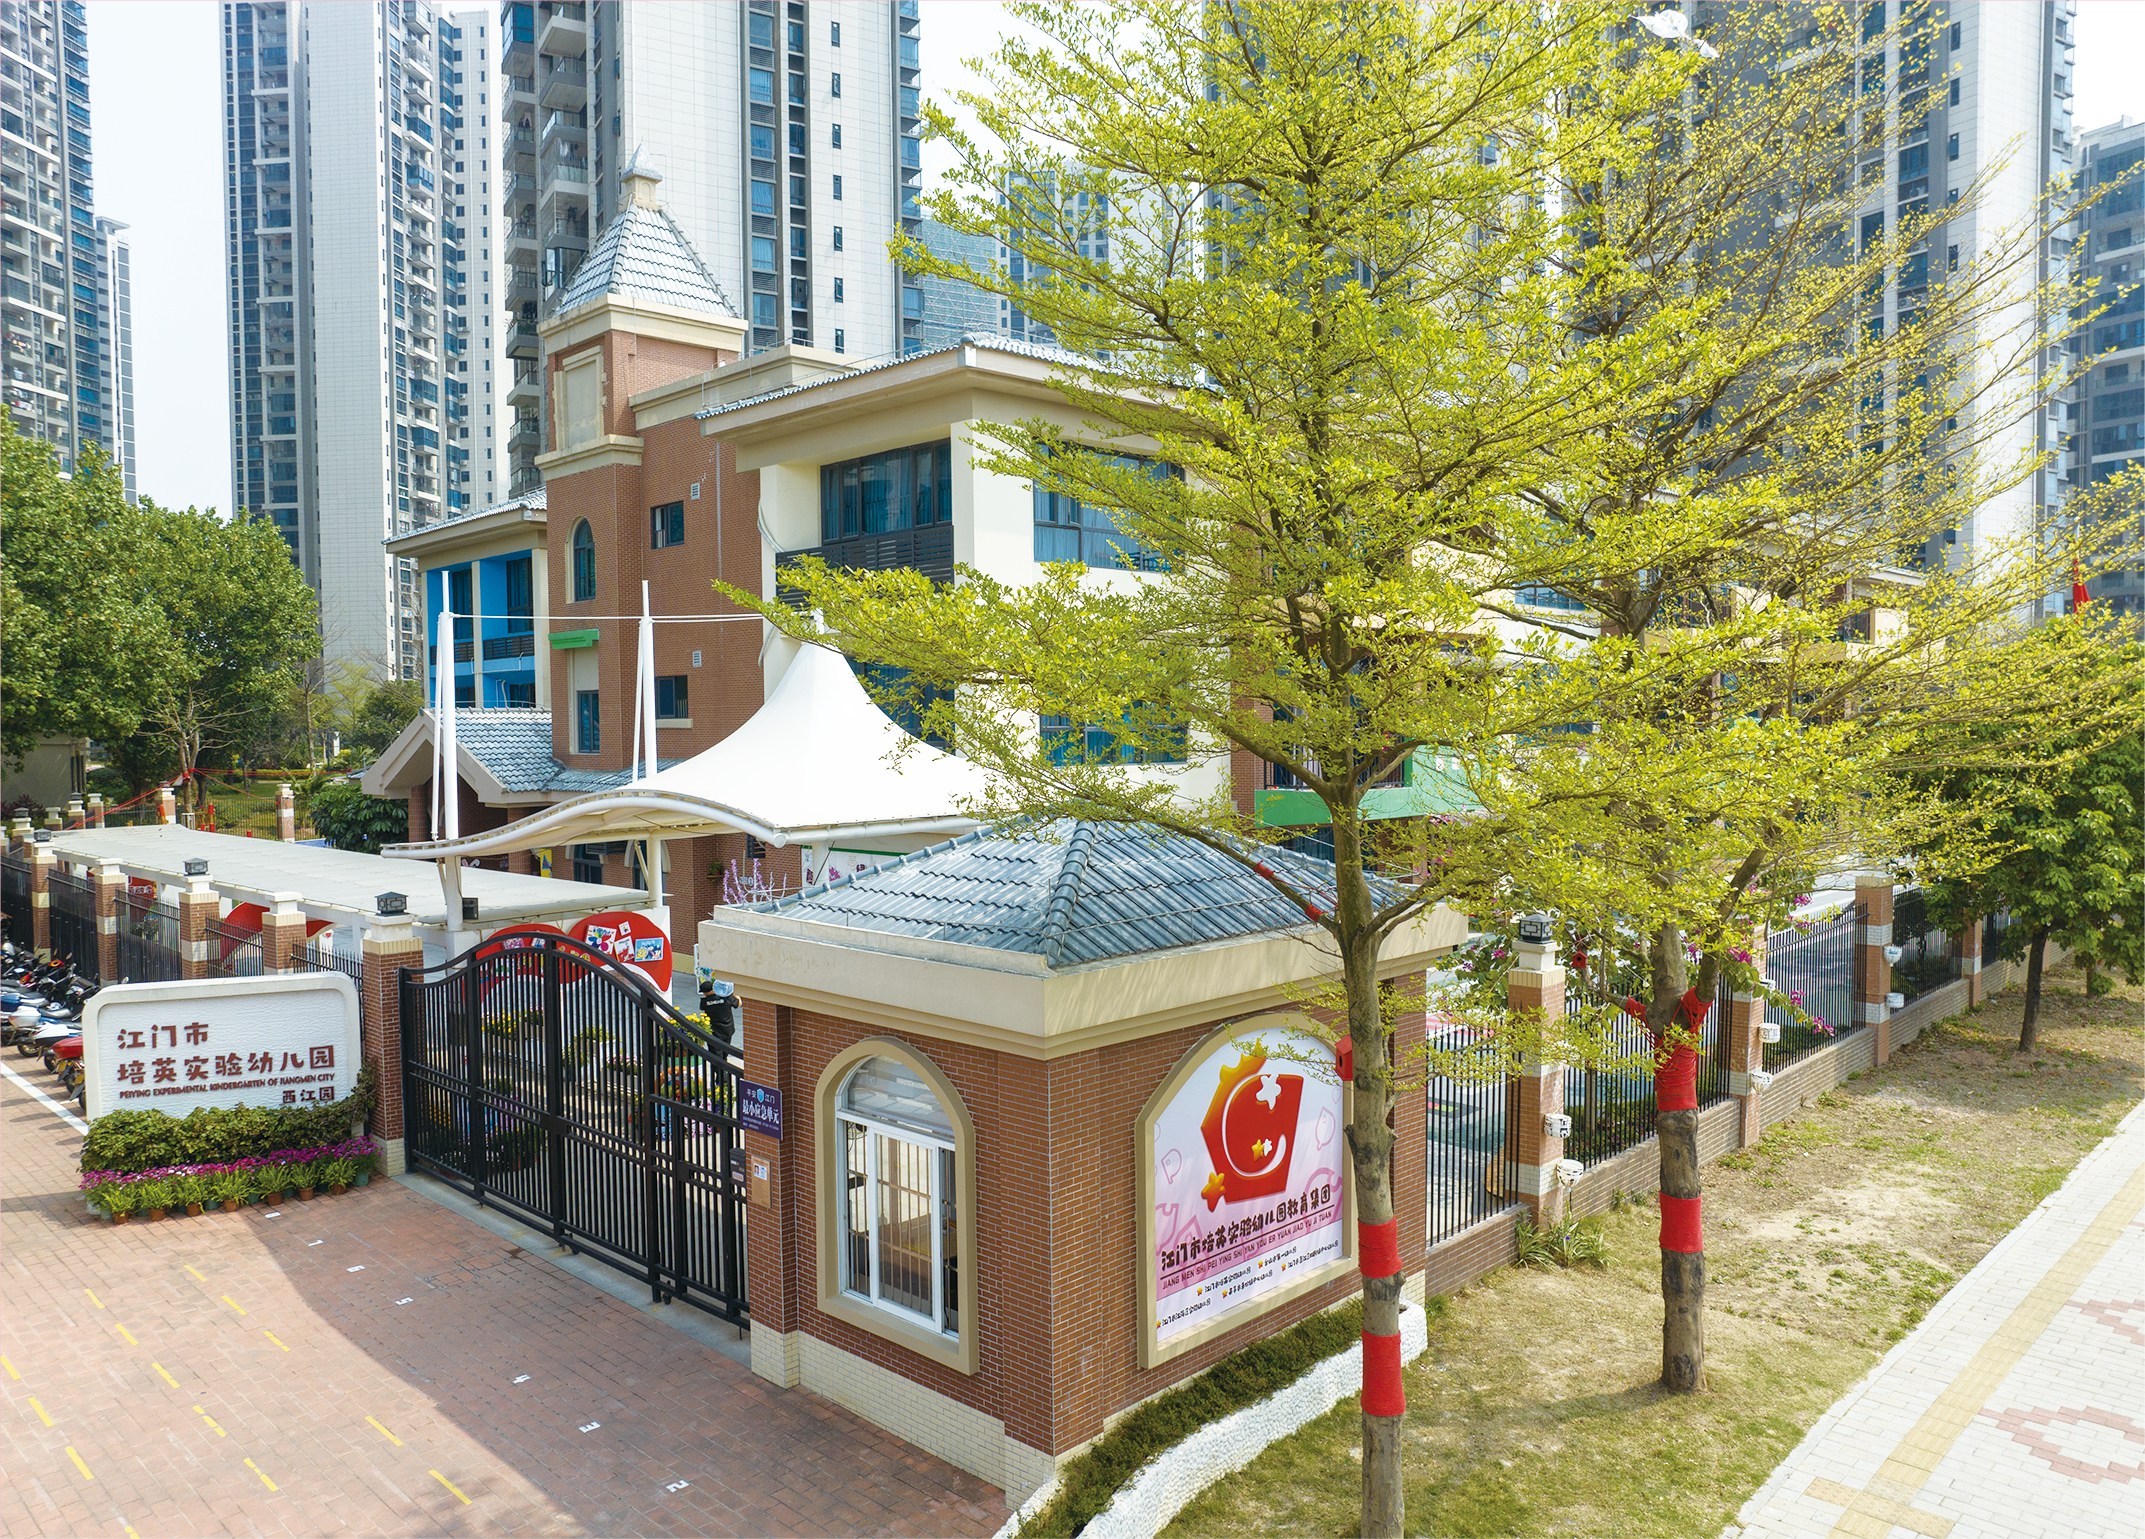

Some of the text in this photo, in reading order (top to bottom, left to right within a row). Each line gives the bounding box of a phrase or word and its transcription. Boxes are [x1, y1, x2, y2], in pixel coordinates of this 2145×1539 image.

[117, 1022, 209, 1049] 江门市
[117, 1045, 335, 1084] 培英实验幼儿园
[119, 1073, 335, 1099] PEIYING EXPERIMENTAL KINDERGARTEN OF JIANGMEN CITY
[283, 1086, 335, 1103] 西江园
[743, 1099, 779, 1124] 最小应急单元
[1161, 1183, 1331, 1271] 江门市培英实验幼儿园教育集团
[1162, 1210, 1332, 1290] JIANG MEN SHI PEI YING SHI YAN YOU ER YUAN JIAO YU JI TUAN
[395, 1297, 414, 1306] 5
[579, 1421, 601, 1433] 3
[666, 1479, 690, 1493] 2
